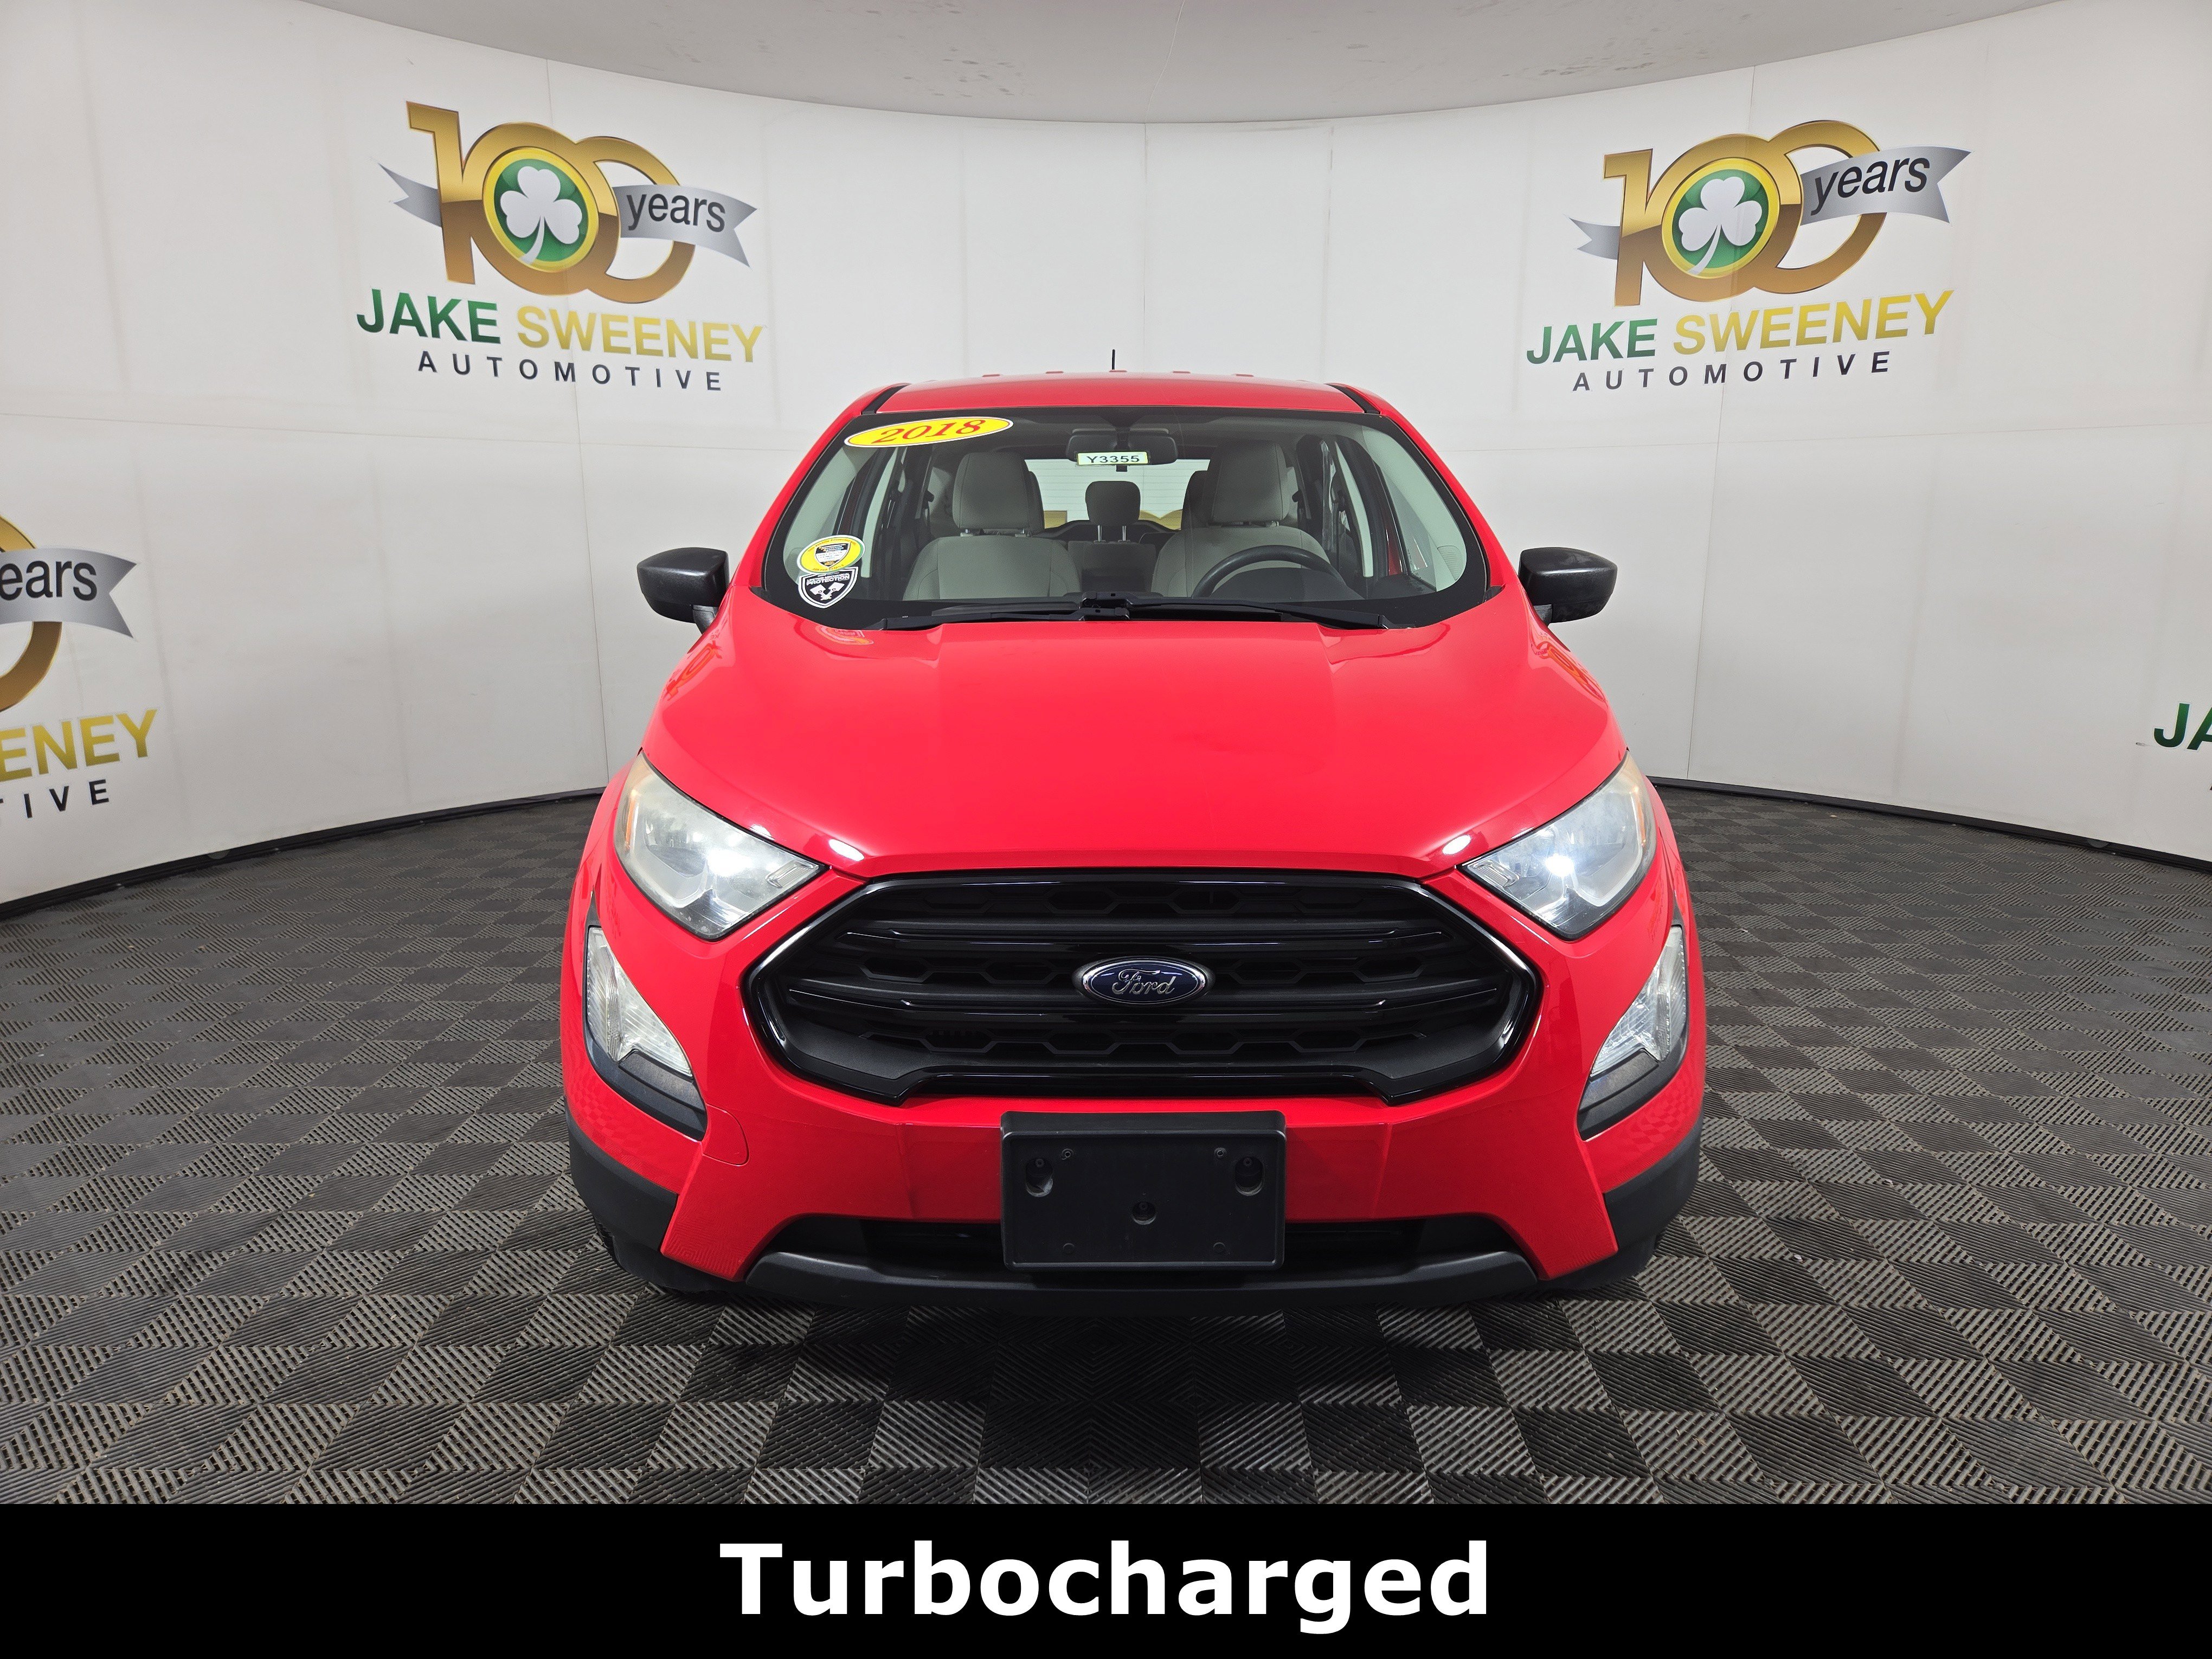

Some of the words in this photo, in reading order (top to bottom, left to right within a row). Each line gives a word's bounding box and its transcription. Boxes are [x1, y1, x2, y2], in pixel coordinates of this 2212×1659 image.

[406, 101, 696, 304] 100
[626, 192, 725, 232] years
[1603, 120, 1887, 307] 100
[1811, 157, 1930, 215] years
[357, 288, 501, 344] JAKE
[517, 306, 762, 363] SWEENEY
[1527, 319, 1658, 364] JAKE
[1674, 290, 1954, 355] SWEENEY
[418, 351, 721, 391] AUTOMOTIVE
[1573, 351, 1890, 391] AUTOMOTIVE
[871, 420, 986, 443] 2018
[0, 560, 97, 601] ears
[0, 779, 109, 818] IVE
[1112, 968, 1176, 994] Ford
